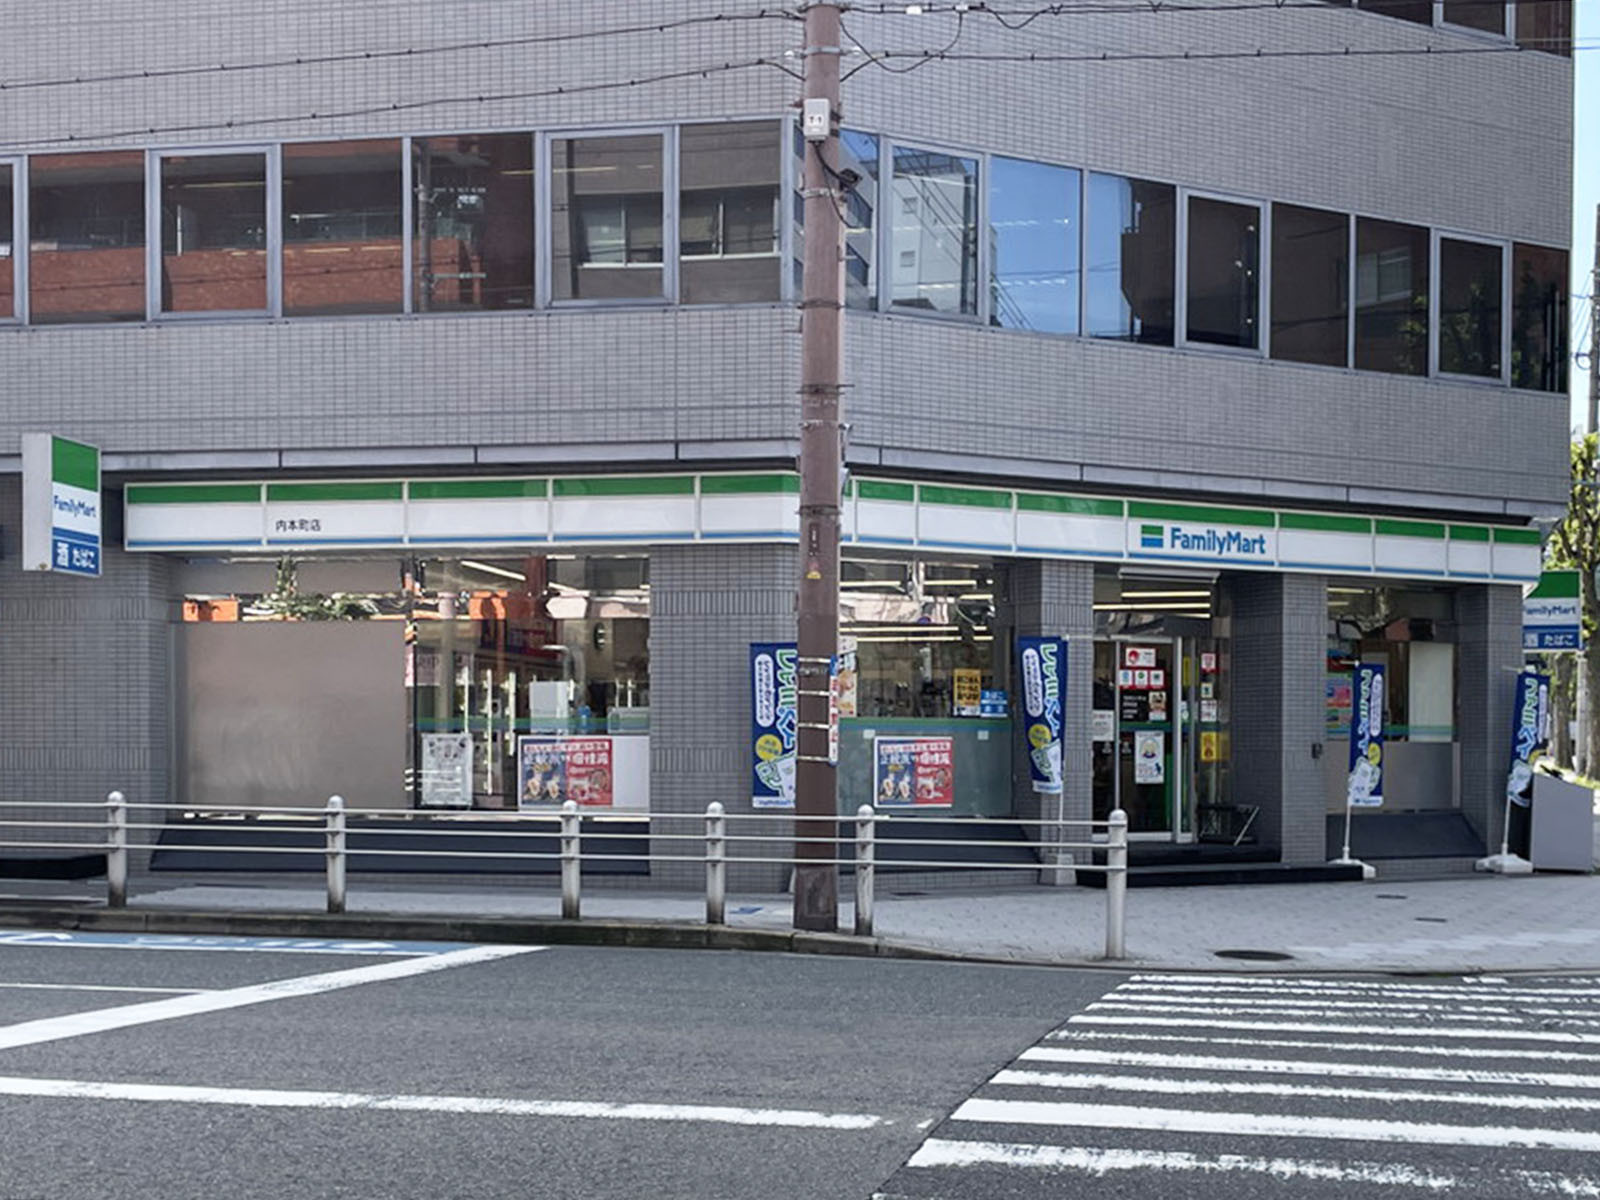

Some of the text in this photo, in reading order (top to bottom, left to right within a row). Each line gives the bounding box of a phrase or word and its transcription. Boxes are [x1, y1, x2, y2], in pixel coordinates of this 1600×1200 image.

[53, 495, 97, 518] FamilyMart
[275, 519, 321, 532] 内本町店
[1170, 526, 1266, 555] FamilyMart
[72, 548, 95, 569] たばこ
[1525, 605, 1577, 617] amilyMart
[1543, 633, 1574, 646] たばこ
